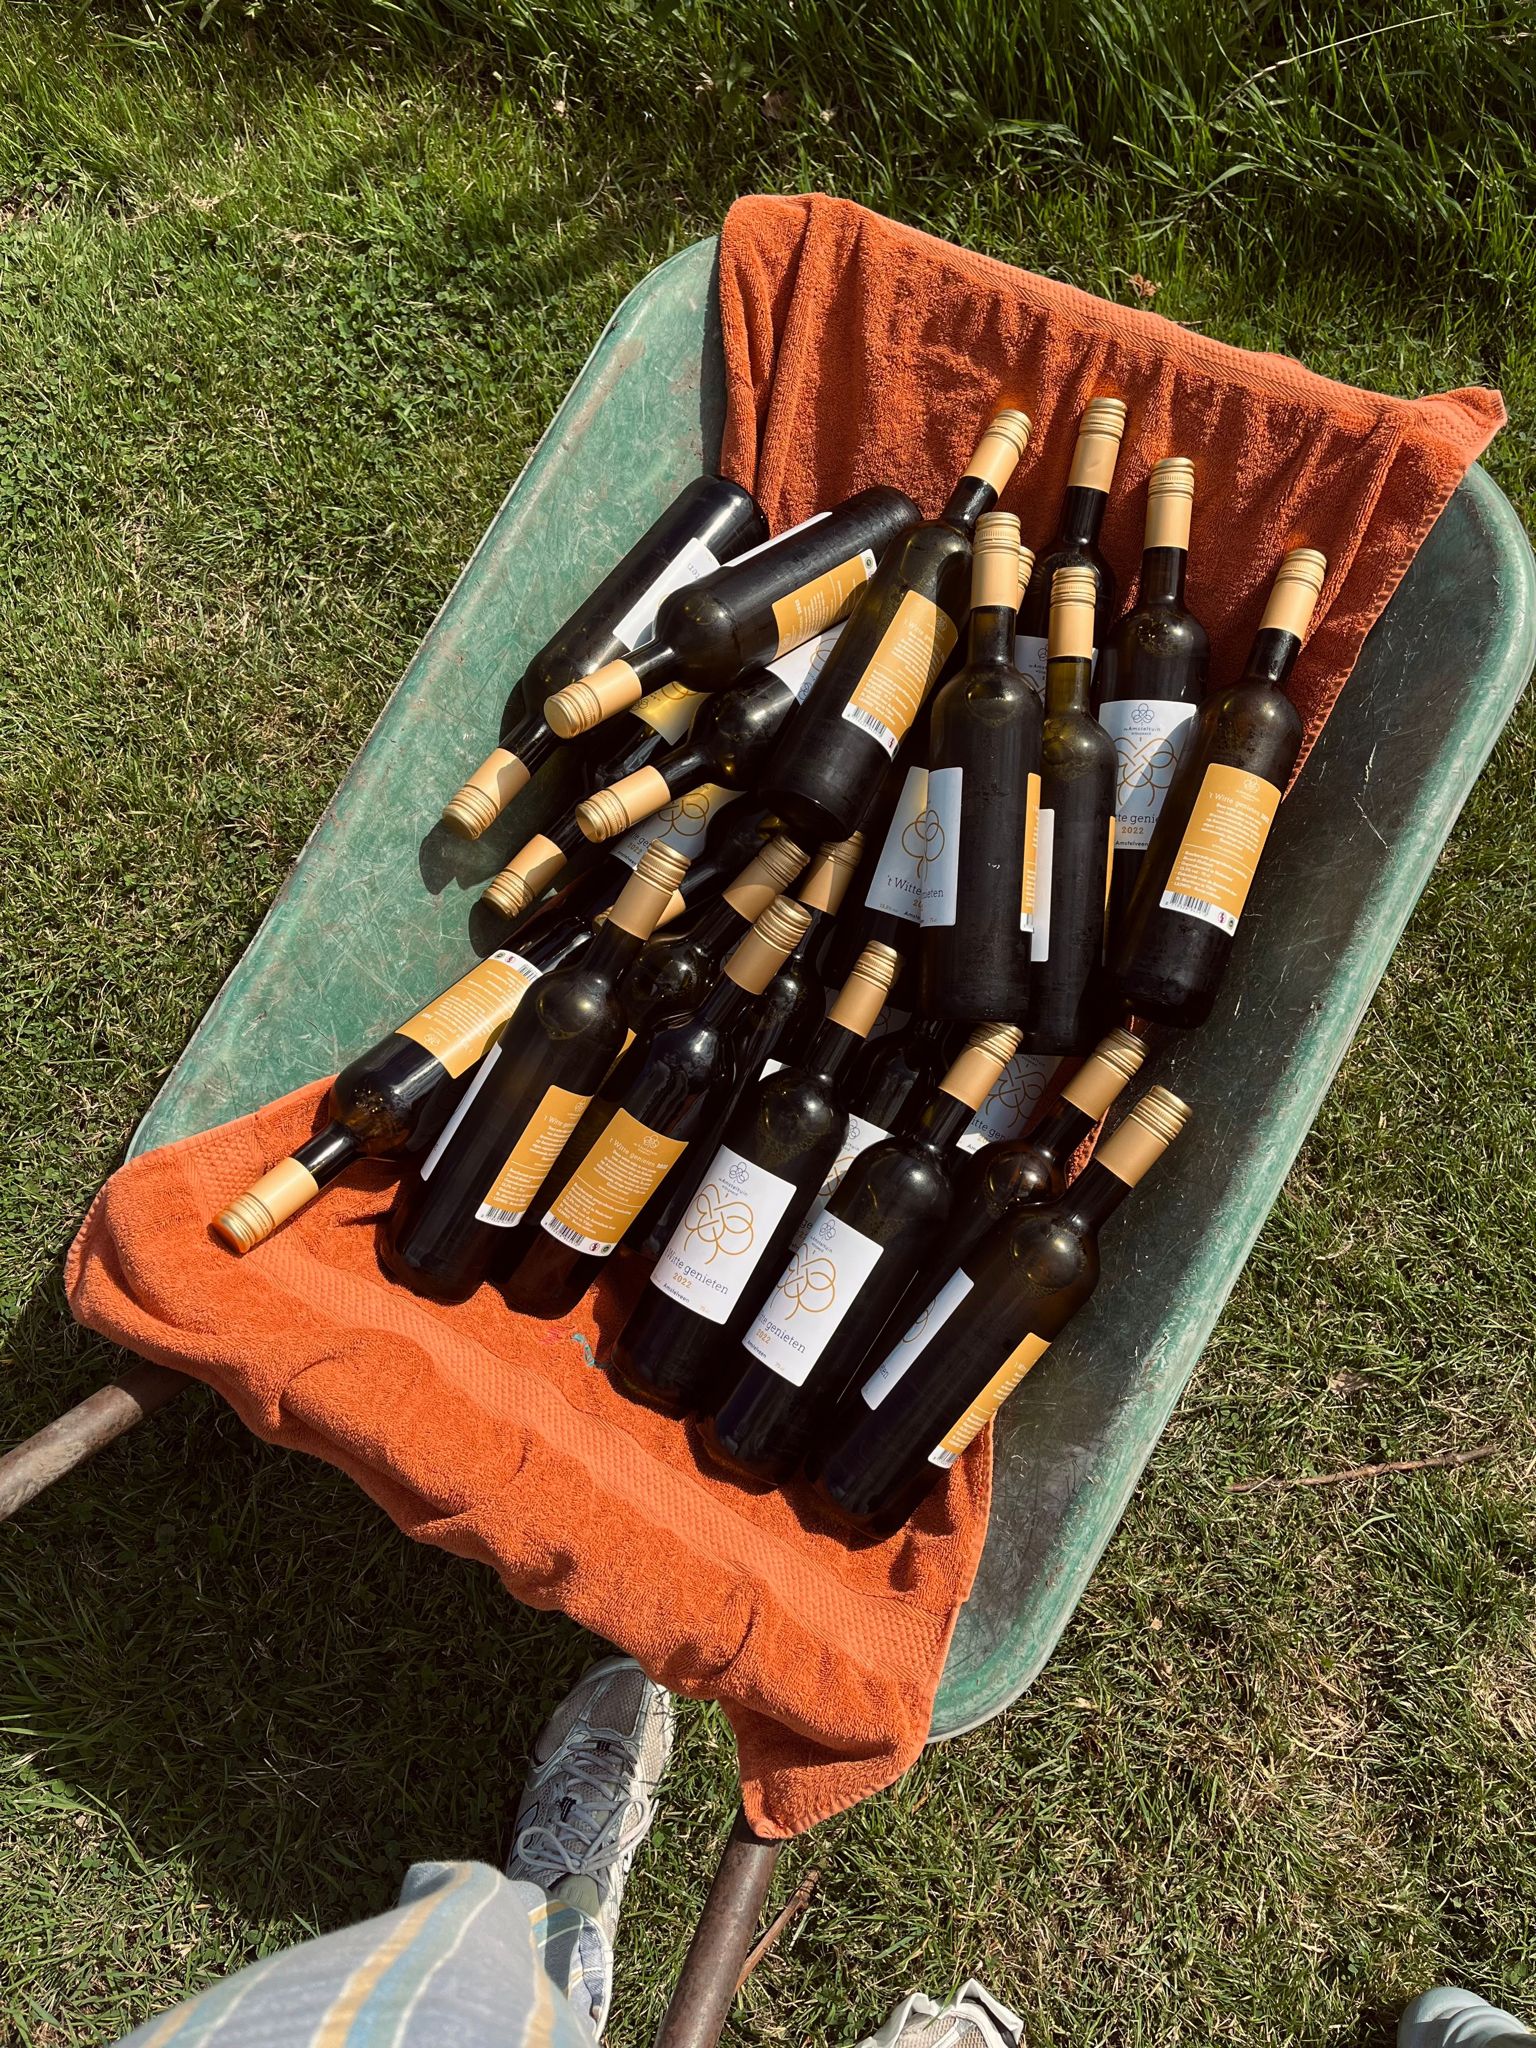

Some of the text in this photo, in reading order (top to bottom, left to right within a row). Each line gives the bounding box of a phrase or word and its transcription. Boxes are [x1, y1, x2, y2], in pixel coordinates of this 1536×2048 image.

[1121, 826, 1144, 835] 2022
[887, 875, 922, 896] 't Witte
[672, 1272, 693, 1289] 2022
[683, 1264, 729, 1295] genieten
[663, 1282, 690, 1303] Amstelveen
[755, 1328, 771, 1345] 2022
[765, 1321, 806, 1354] genieten
